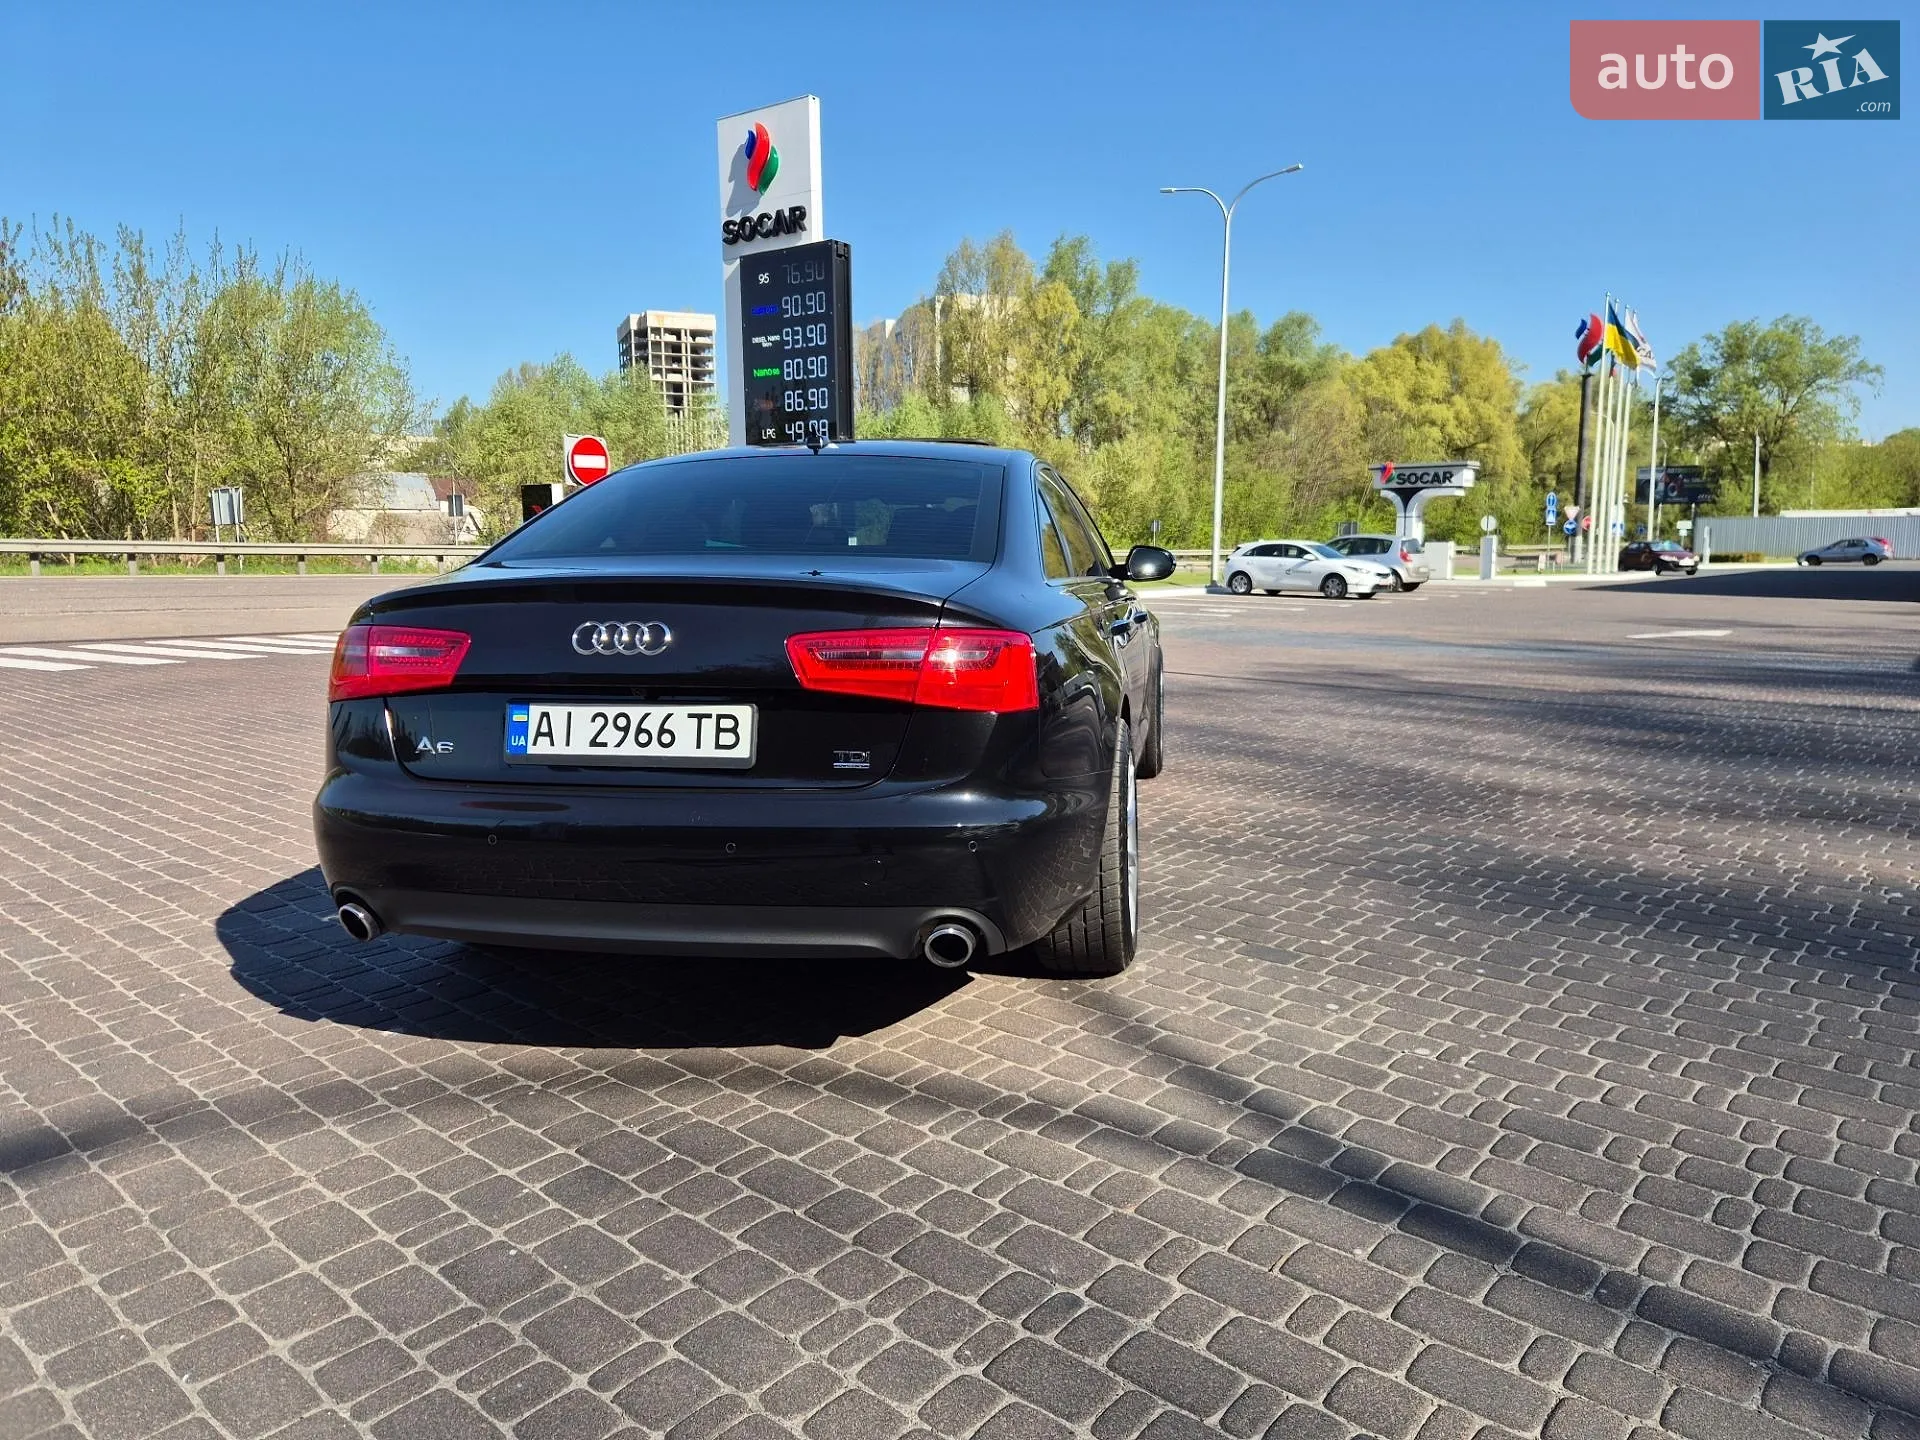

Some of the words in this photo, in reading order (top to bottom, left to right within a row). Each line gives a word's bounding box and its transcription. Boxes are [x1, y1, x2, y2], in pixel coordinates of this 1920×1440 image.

[722, 205, 807, 246] SOCAR
[758, 272, 770, 285] 95
[781, 291, 826, 318] 90.90
[783, 323, 827, 349] 93.90
[783, 355, 828, 381] 80.90
[784, 387, 829, 412] 86.90
[761, 428, 776, 440] LPG
[1395, 470, 1454, 486] SOCAR
[511, 735, 526, 747] UA
[531, 711, 571, 748] AI
[589, 711, 677, 750] 2966
[688, 712, 740, 751] TB
[415, 736, 455, 756] A6
[833, 750, 871, 763] TDI
